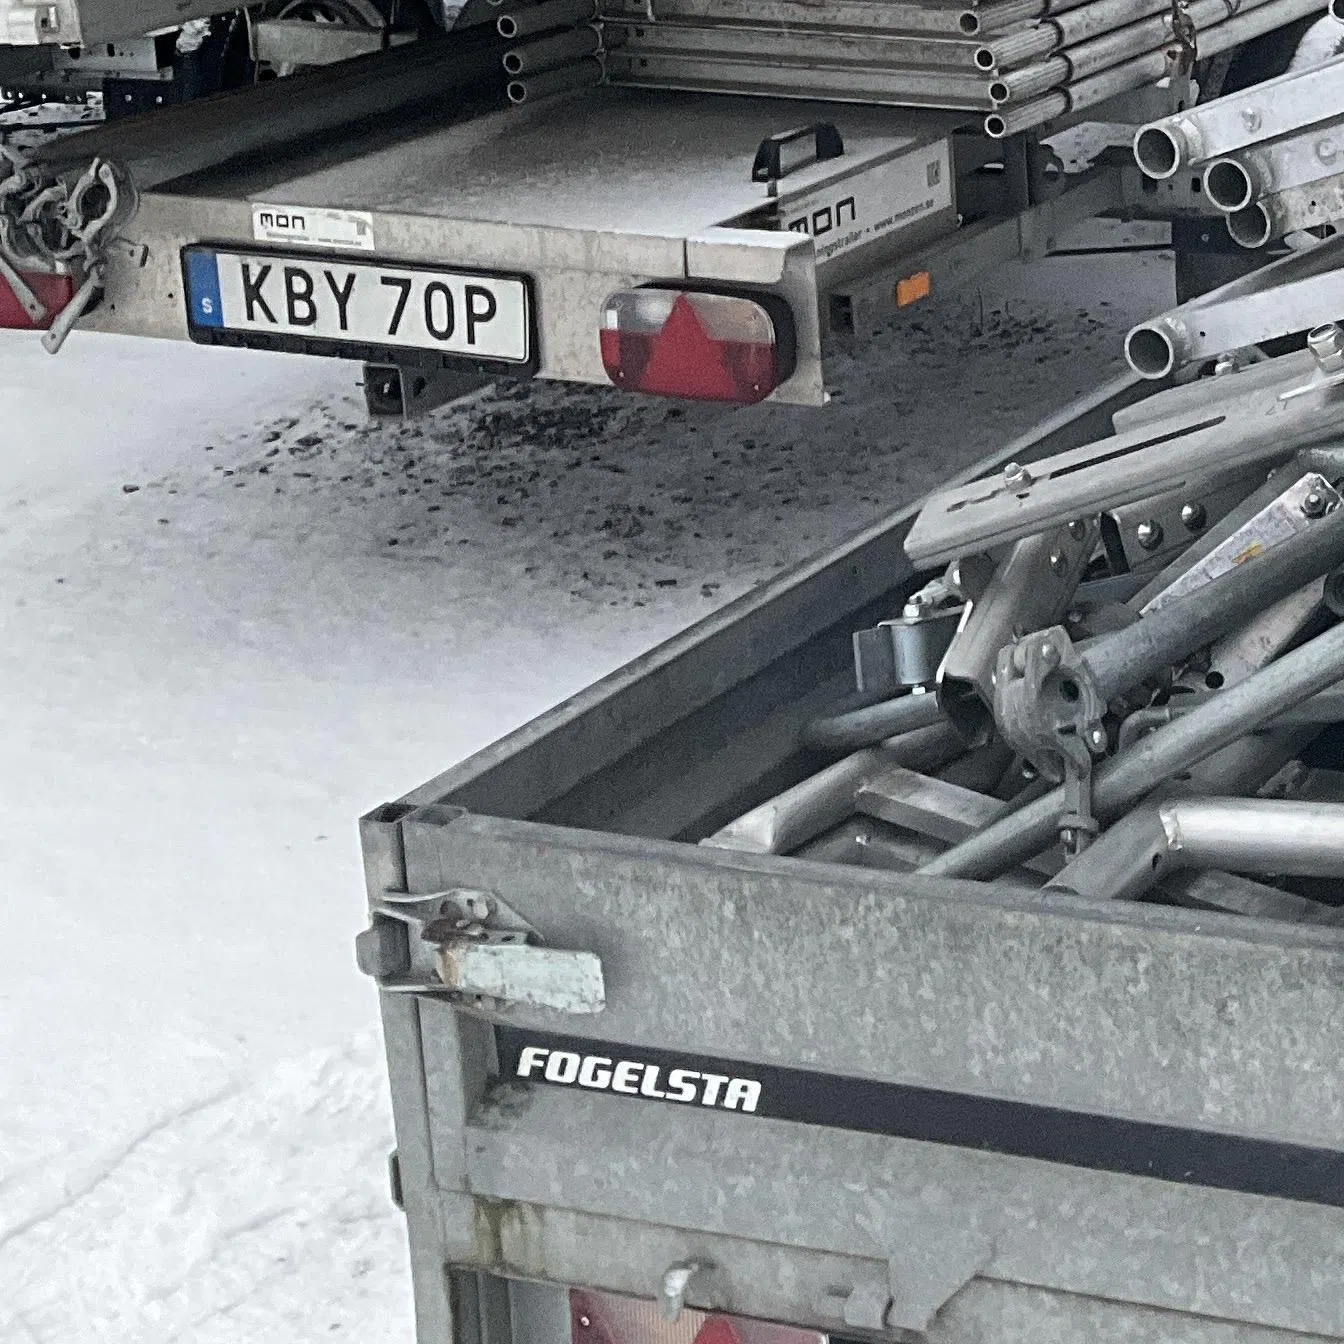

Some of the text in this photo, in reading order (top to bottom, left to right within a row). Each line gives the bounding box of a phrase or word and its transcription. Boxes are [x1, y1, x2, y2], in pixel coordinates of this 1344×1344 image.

[201, 297, 214, 314] S
[241, 263, 498, 345] KBY 70P
[516, 1046, 763, 1113] FOGELSTA
